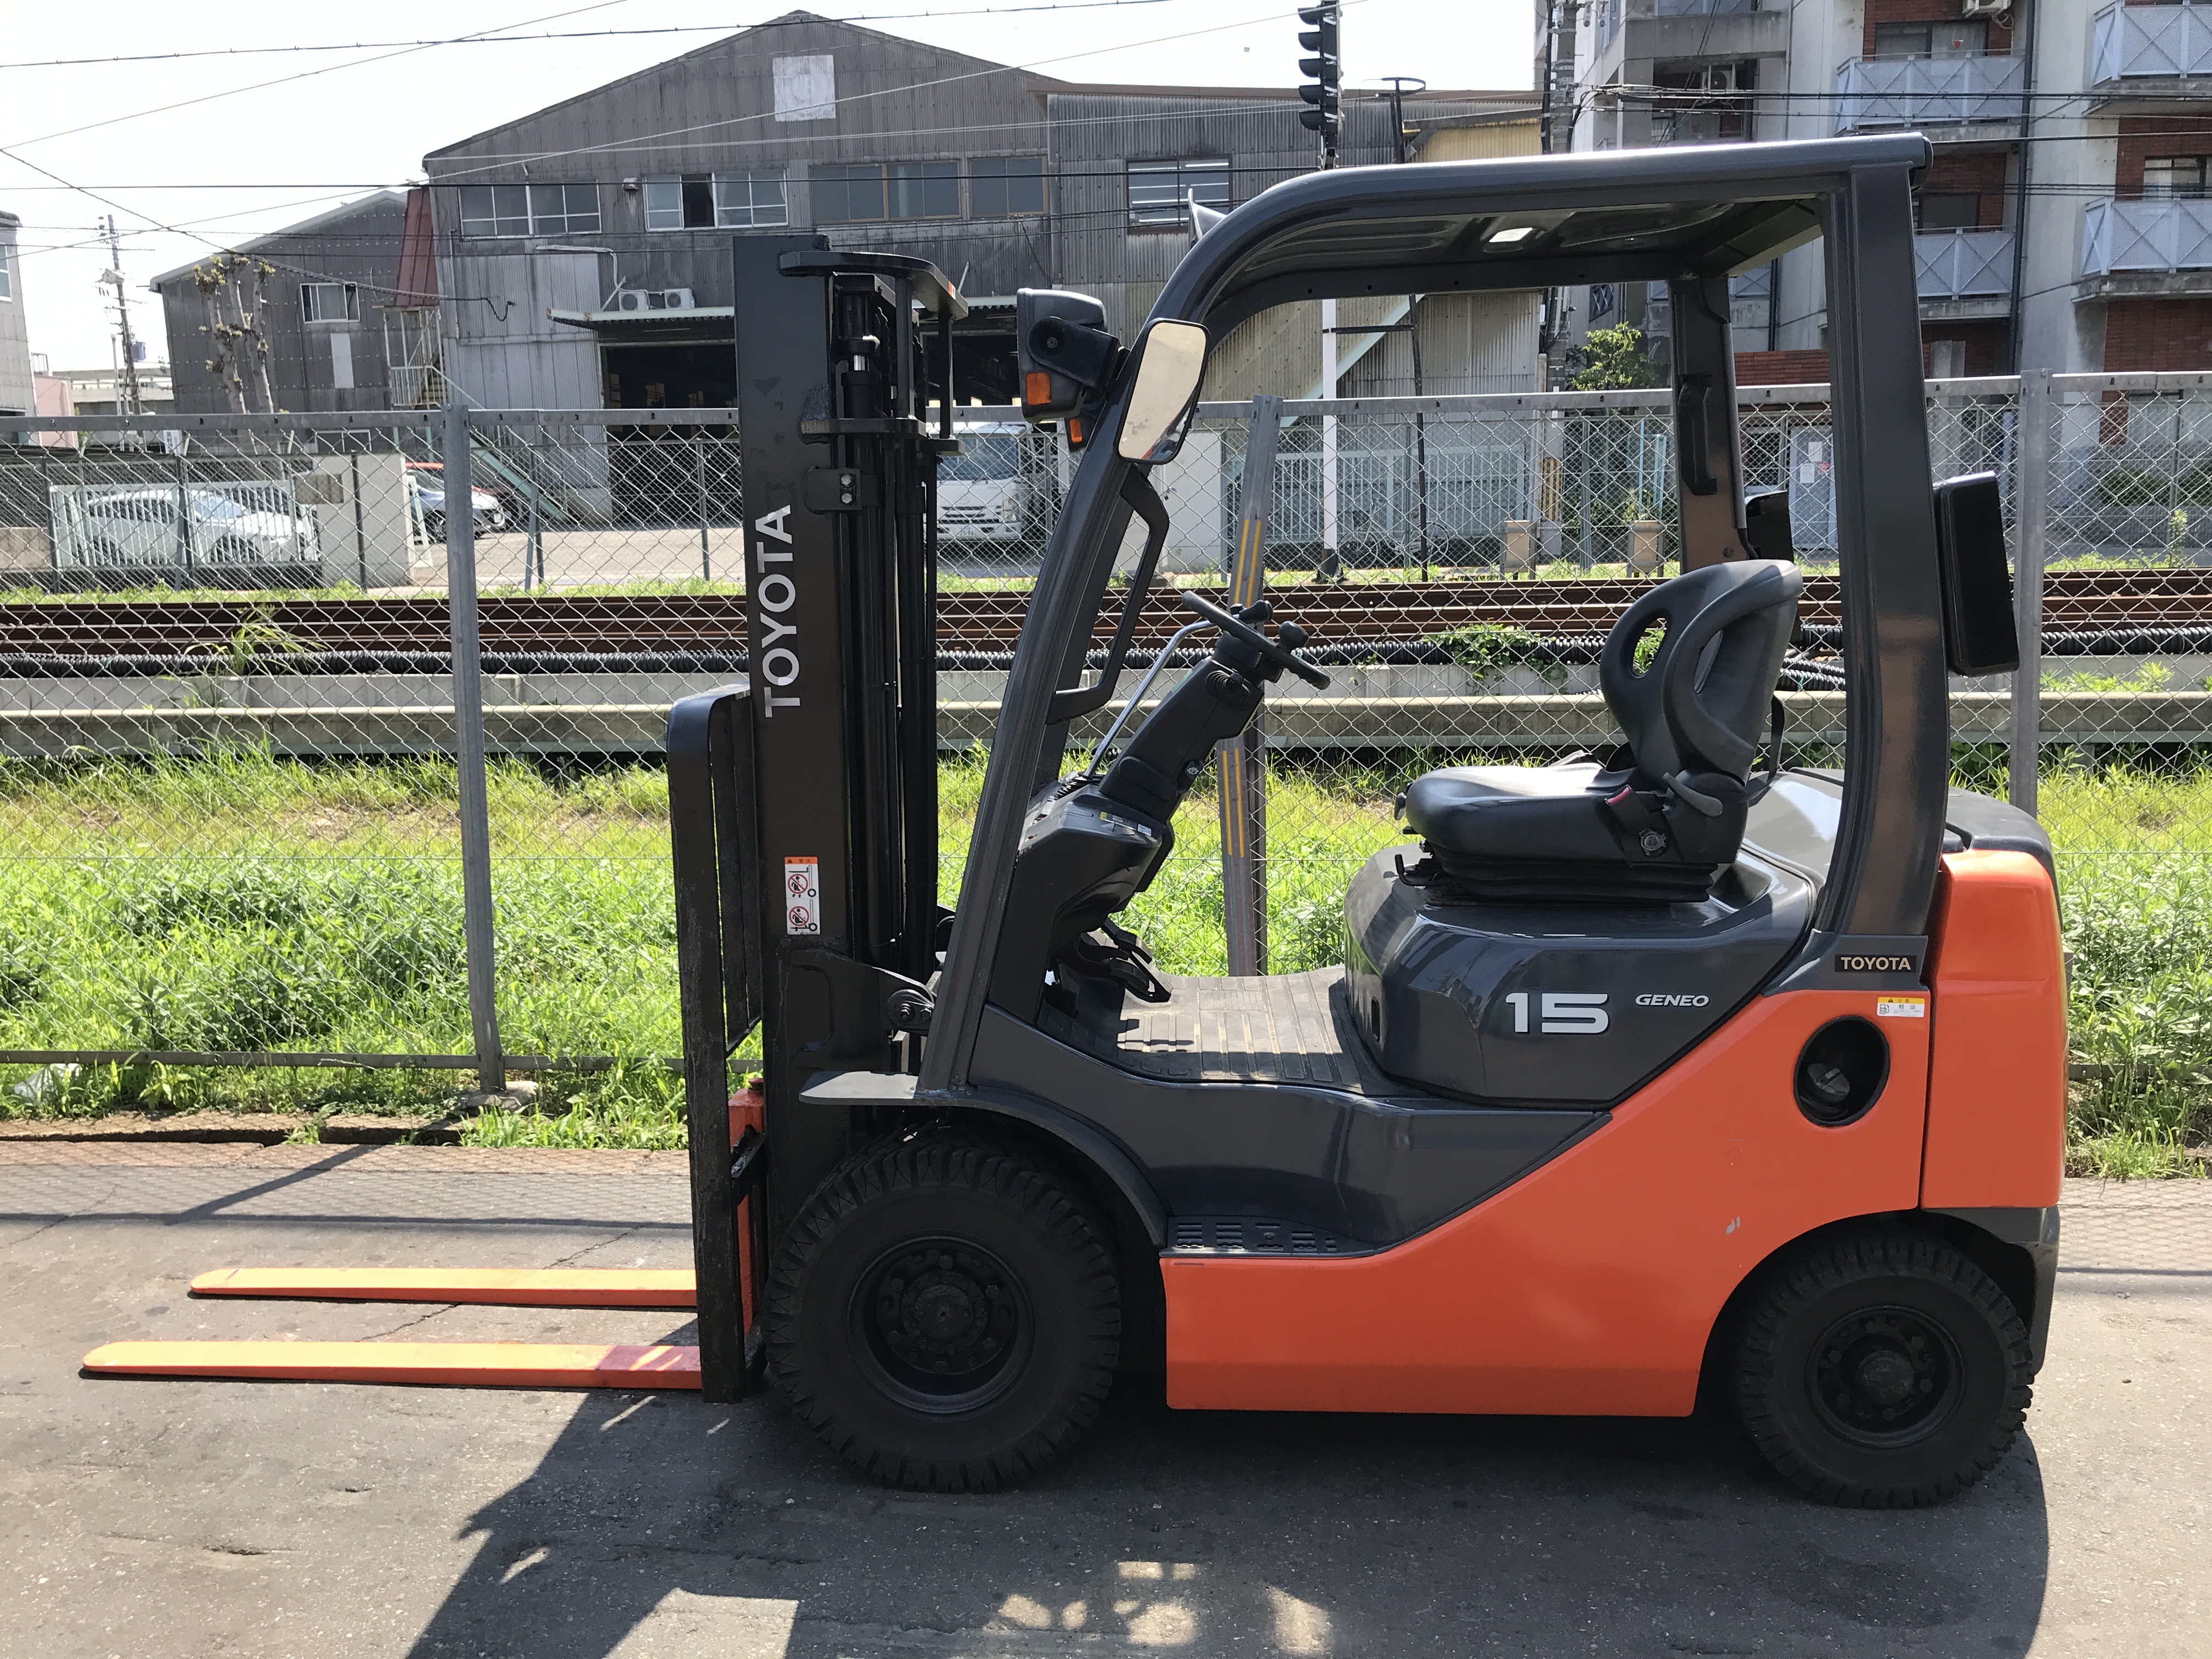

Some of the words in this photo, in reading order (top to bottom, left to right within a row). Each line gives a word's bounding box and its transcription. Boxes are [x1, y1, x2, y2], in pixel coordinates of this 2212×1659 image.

[755, 504, 800, 718] TOYOTA
[1840, 956, 1912, 970] TOYOTA
[1505, 992, 1609, 1034] 15
[1634, 994, 1709, 1007] GENEO
